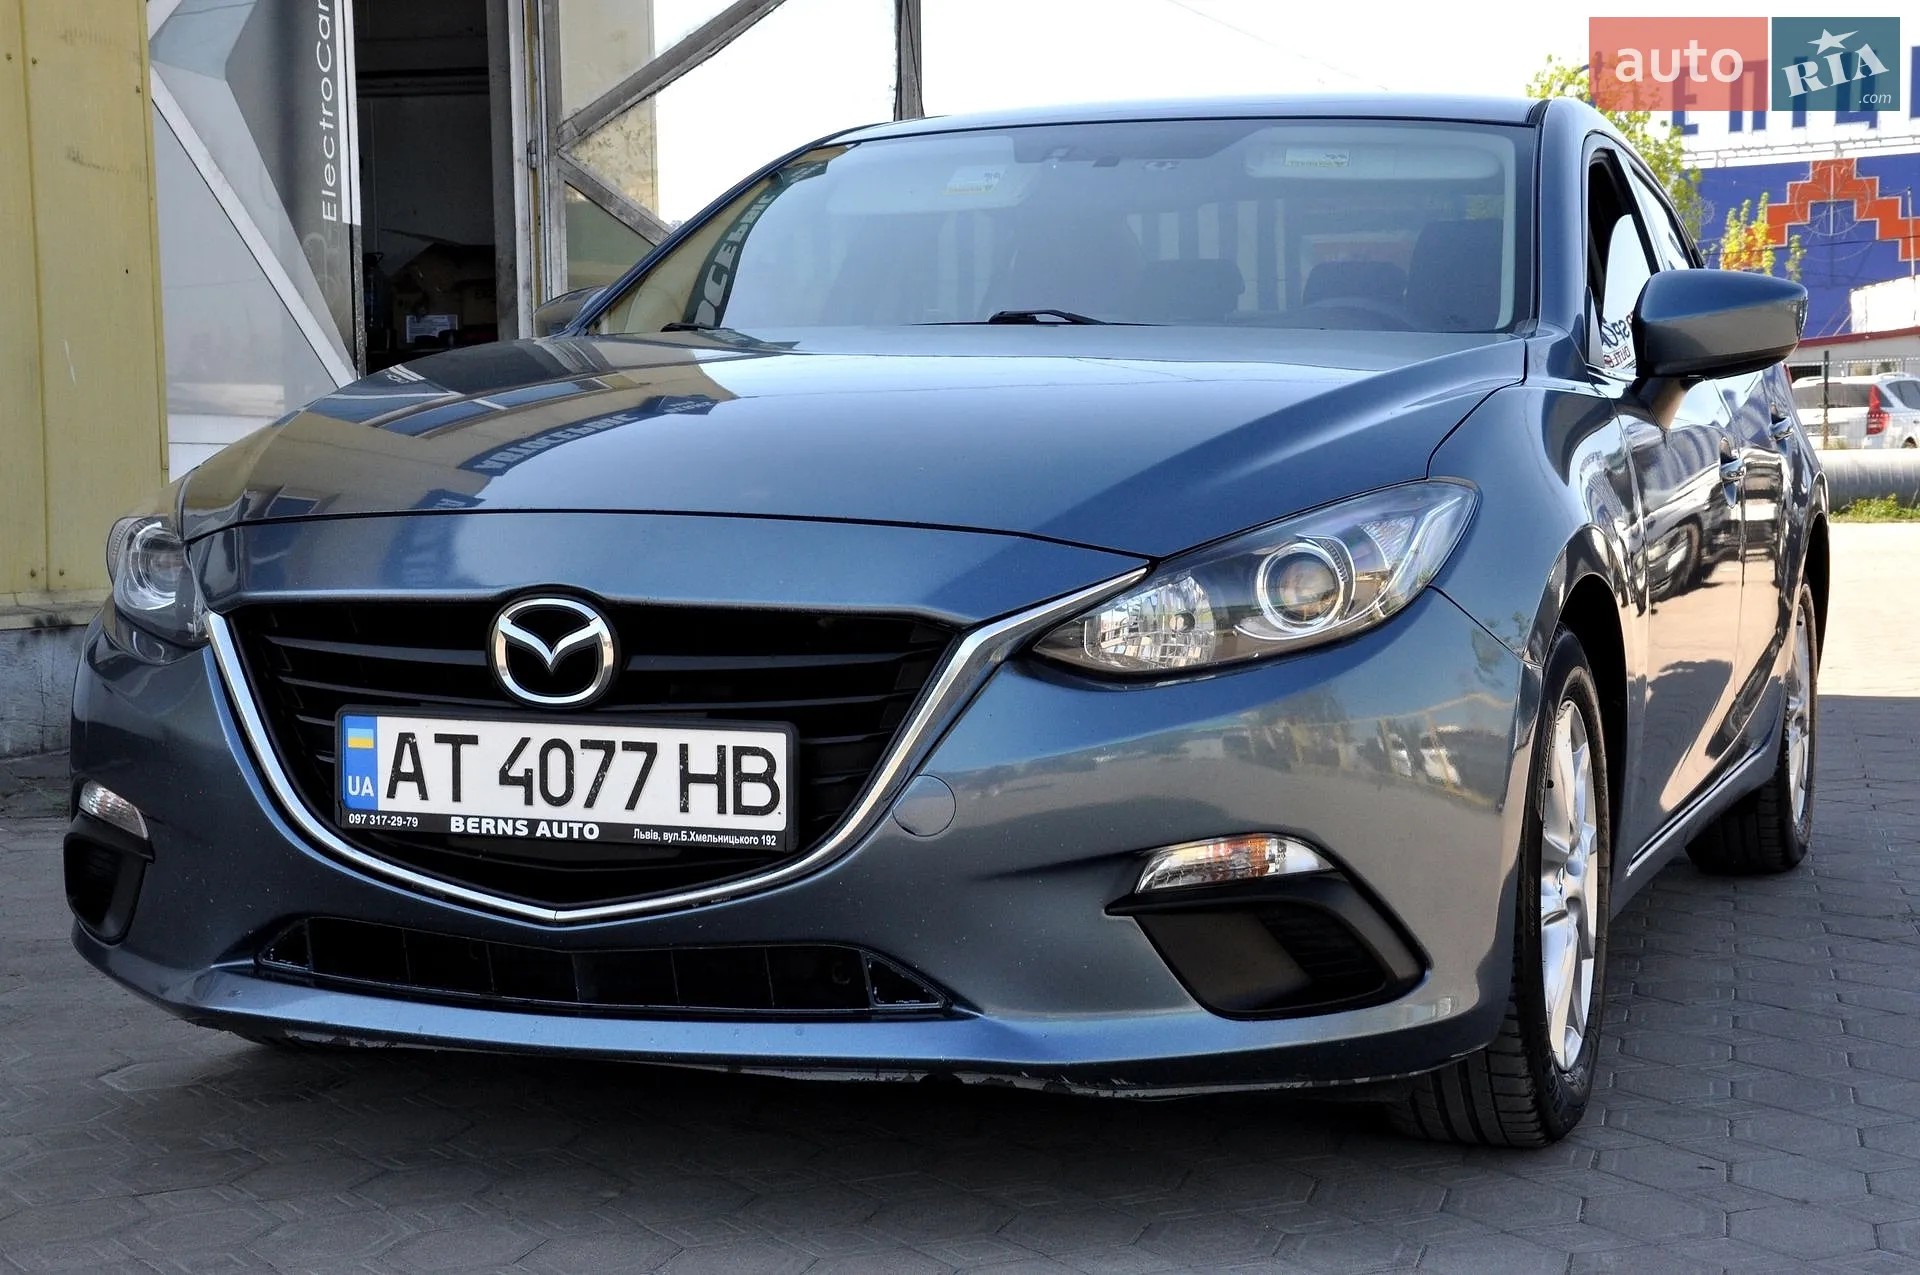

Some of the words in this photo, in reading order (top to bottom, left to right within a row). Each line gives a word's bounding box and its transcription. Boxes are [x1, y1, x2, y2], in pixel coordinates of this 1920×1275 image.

[386, 731, 478, 803] AT
[499, 737, 658, 810] 4077
[679, 743, 780, 816] HB
[347, 776, 374, 797] UA
[348, 813, 367, 824] 097
[369, 814, 419, 828] 317-29-79
[450, 816, 529, 836] BERNS
[535, 821, 600, 840] AUTO
[761, 834, 777, 846] 192
